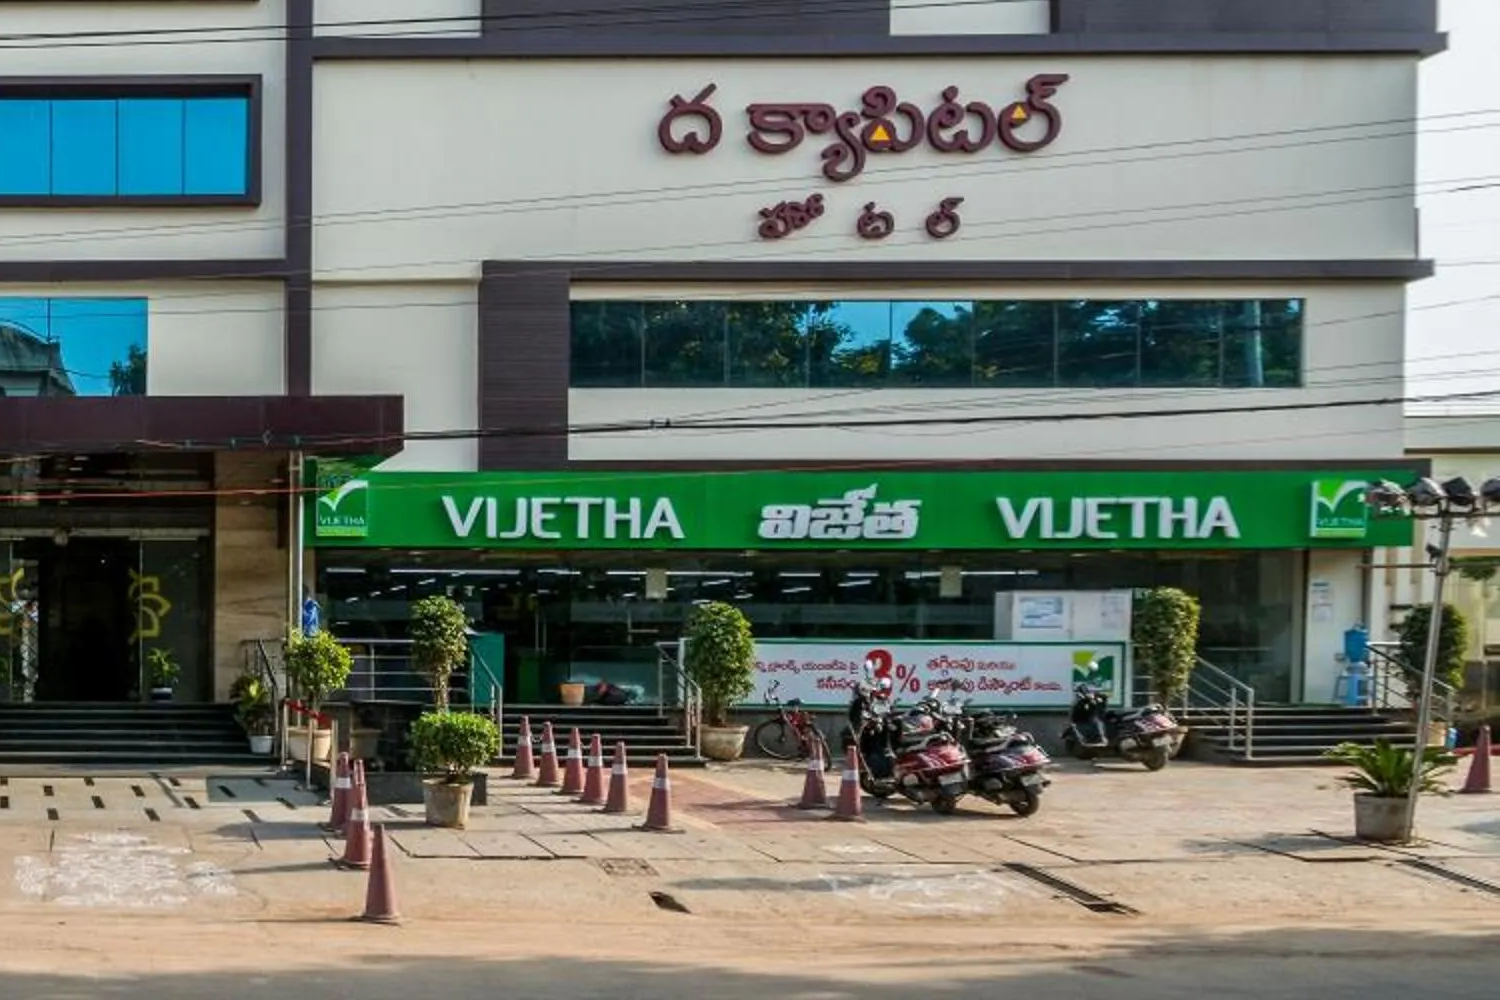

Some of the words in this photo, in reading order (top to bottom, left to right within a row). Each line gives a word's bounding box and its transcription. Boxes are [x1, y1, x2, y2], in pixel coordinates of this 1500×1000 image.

[746, 73, 1070, 182] క్యాపిటల్
[319, 516, 365, 524] VIJETHA
[441, 495, 685, 540] VIJETHA
[758, 482, 922, 541] విజేత
[996, 494, 1240, 541] VIJETHA
